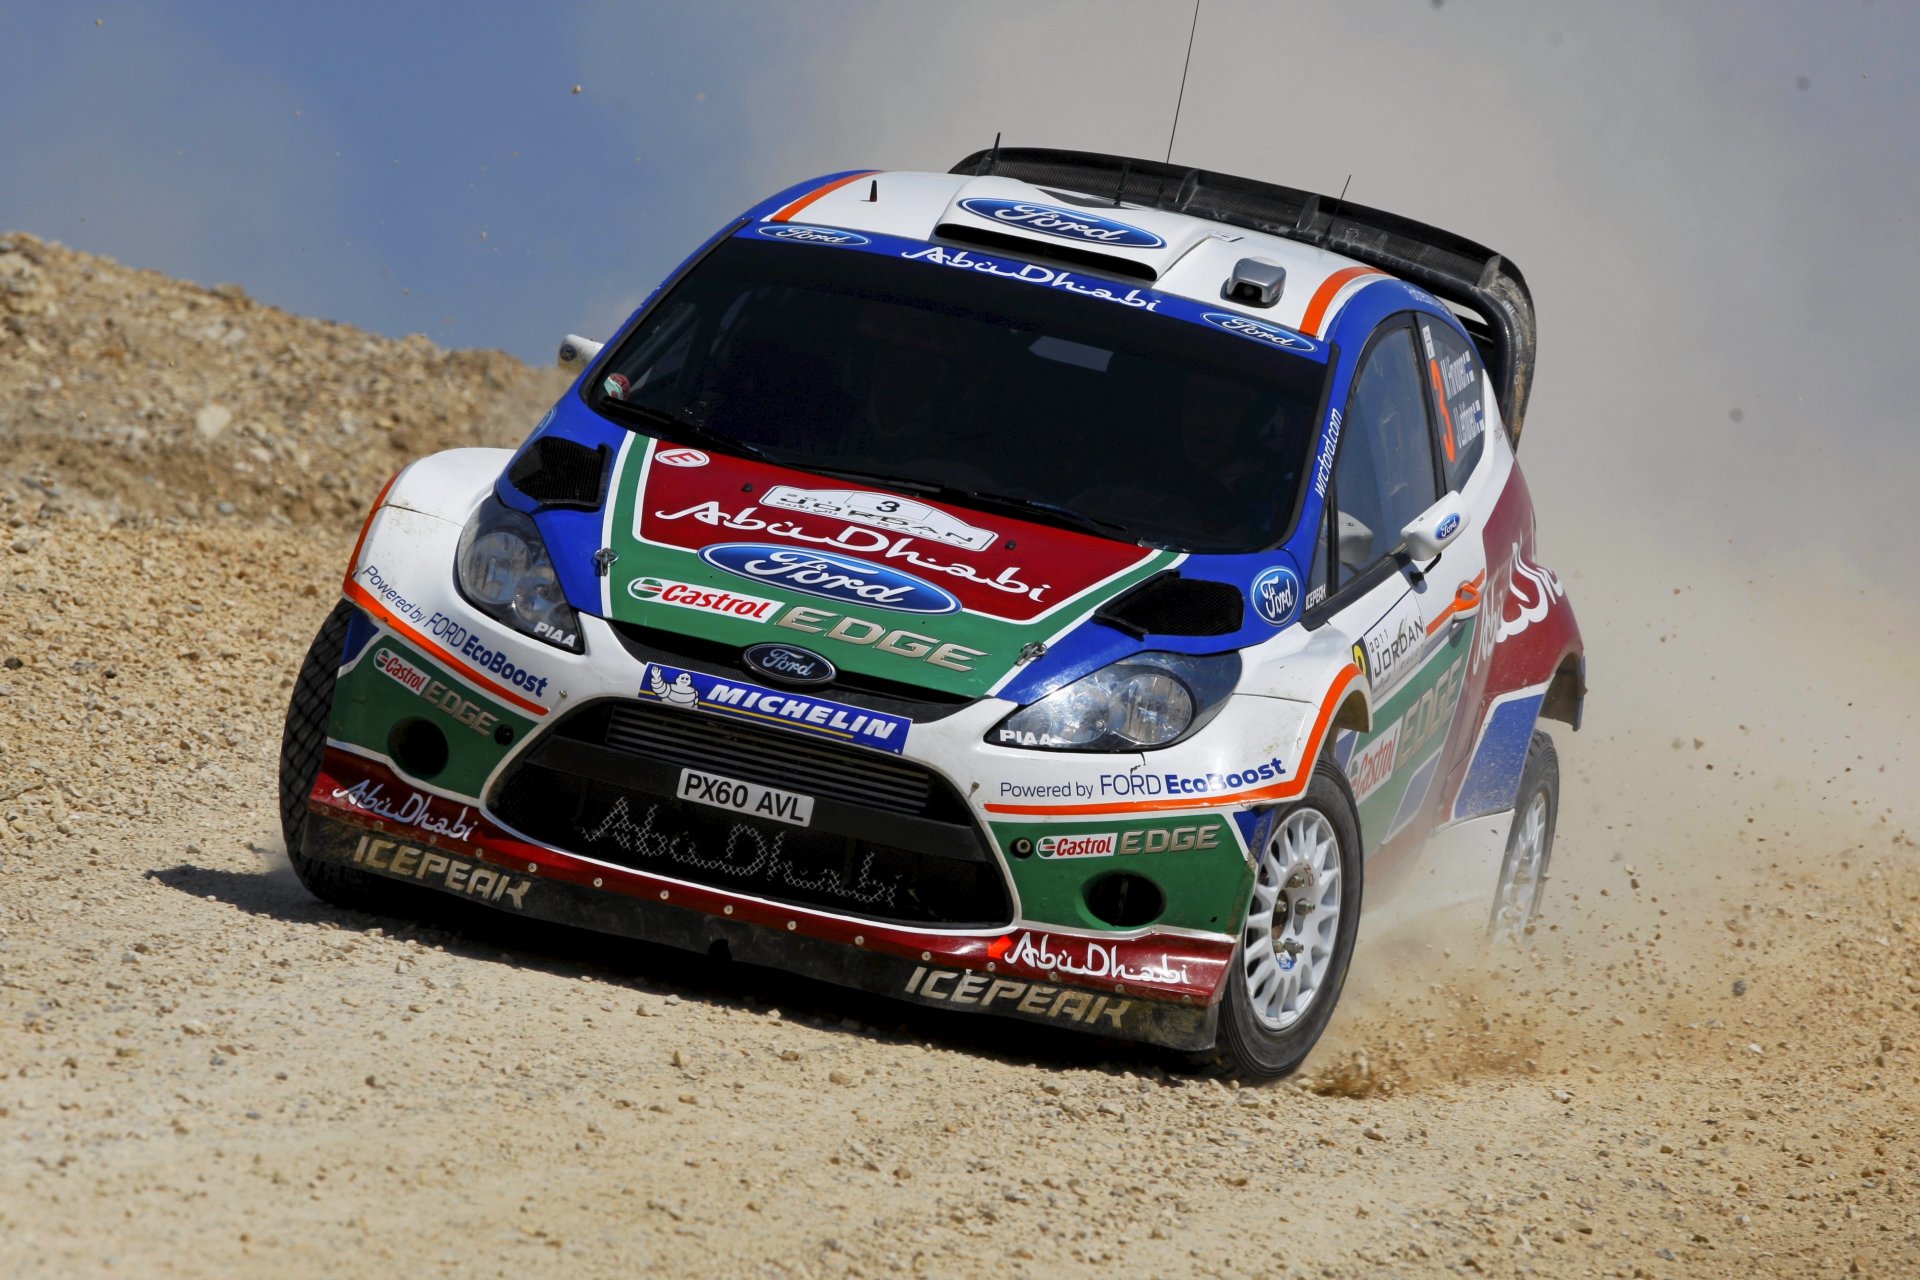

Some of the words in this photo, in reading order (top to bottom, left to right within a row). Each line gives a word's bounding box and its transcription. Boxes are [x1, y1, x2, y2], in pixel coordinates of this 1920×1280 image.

[775, 226, 851, 244] Ford
[995, 204, 1131, 241] Ford
[1221, 317, 1296, 346] Ford
[1430, 359, 1456, 463] 3
[1314, 407, 1343, 499] wrcford.com
[876, 500, 902, 514] 3
[1441, 518, 1458, 537] Ford
[744, 548, 917, 605] Ford
[1260, 575, 1294, 619] Ford
[362, 564, 415, 613] Powered
[410, 601, 428, 624] by
[424, 611, 467, 649] FORD
[460, 634, 549, 698] EcoBoost
[533, 621, 576, 648] PIAA
[661, 583, 771, 620] Castrol
[772, 605, 994, 673] EDGE
[1369, 629, 1390, 653] 2011
[1374, 615, 1425, 678] JORDAN
[762, 648, 816, 677] Ford
[384, 655, 429, 692] Castrol
[422, 679, 499, 737] EDGE
[706, 683, 900, 741] MICHELIN
[999, 728, 1056, 747] PIAA
[1356, 727, 1399, 798] Castrol
[1393, 653, 1464, 775] EDGE
[683, 772, 749, 809] PX60
[755, 790, 805, 823] AVL
[999, 780, 1072, 799] Powered
[1076, 780, 1095, 800] by
[1099, 773, 1162, 797] FORD
[1165, 757, 1286, 795] EcoBoost
[1055, 835, 1113, 857] Castrol
[1118, 823, 1223, 857] EDGE
[352, 834, 532, 910] ICEPEAK
[904, 965, 1134, 1030] ICEPEAK
